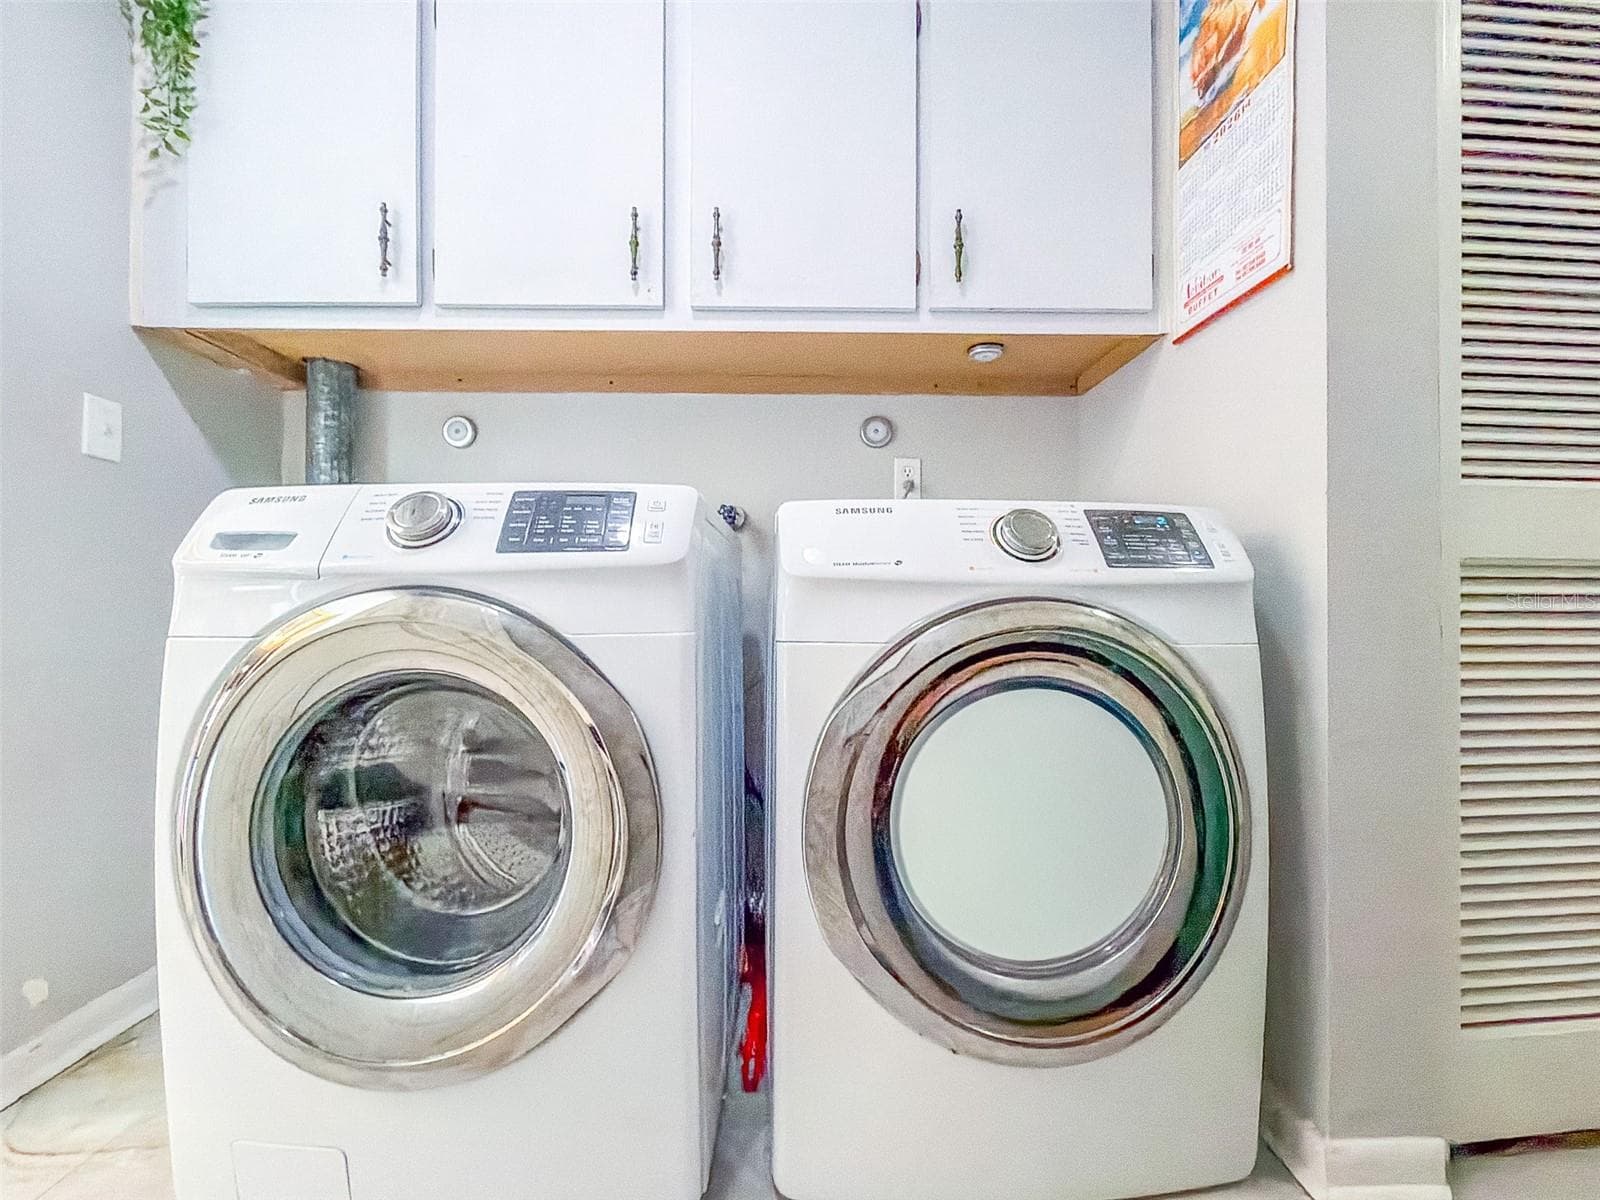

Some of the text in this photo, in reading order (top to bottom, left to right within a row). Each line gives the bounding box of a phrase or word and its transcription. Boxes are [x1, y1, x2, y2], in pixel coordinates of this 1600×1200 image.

[1188, 288, 1218, 315] BUFFET
[248, 495, 307, 505] SAMSUNG
[835, 507, 893, 515] SAMSUNG
